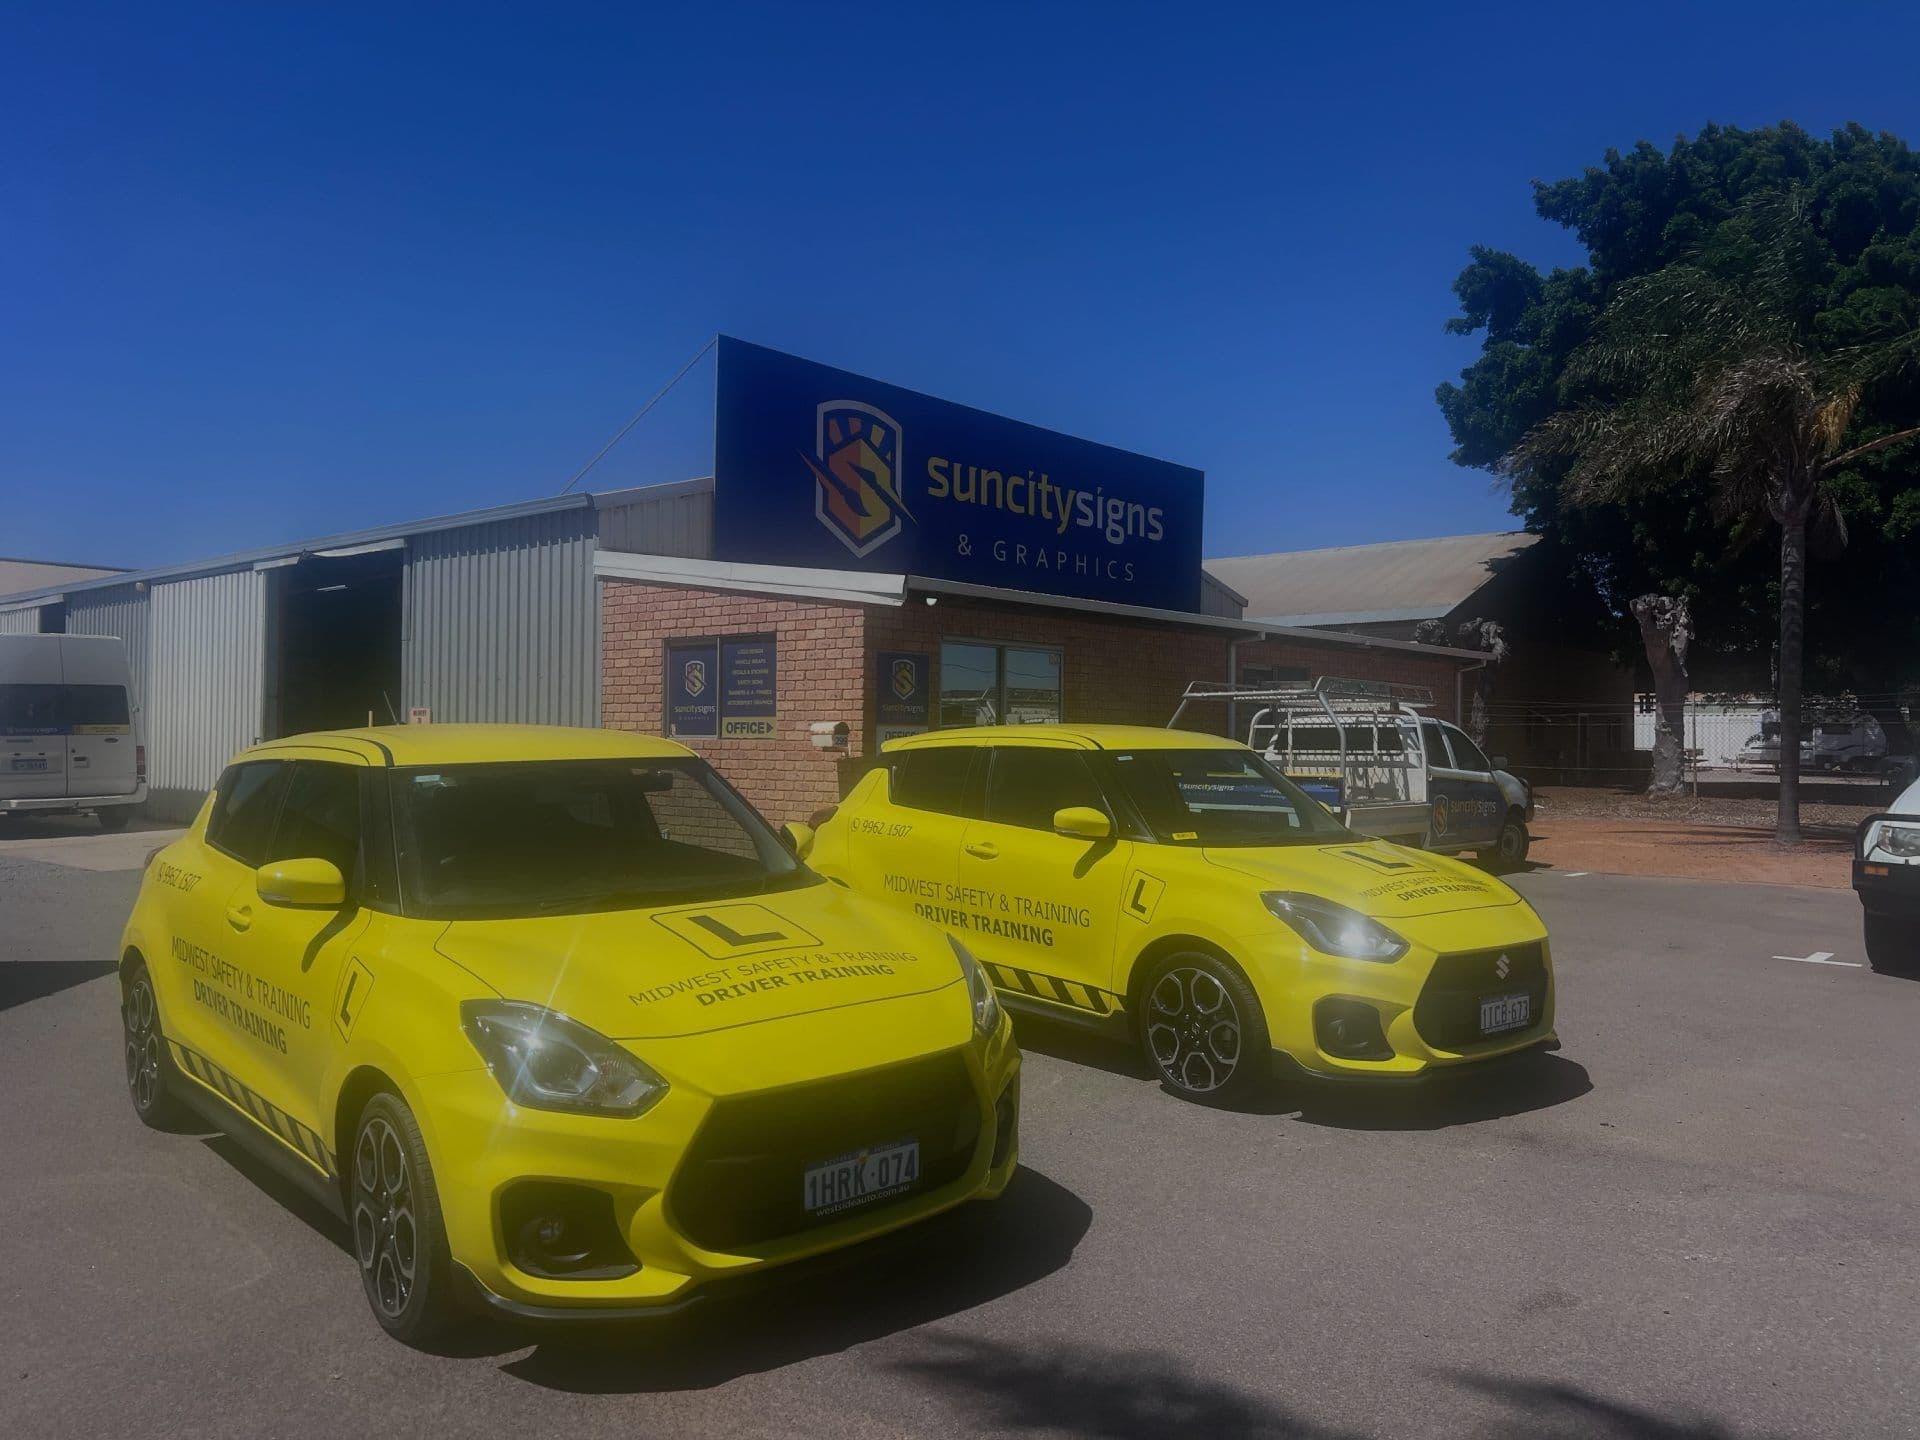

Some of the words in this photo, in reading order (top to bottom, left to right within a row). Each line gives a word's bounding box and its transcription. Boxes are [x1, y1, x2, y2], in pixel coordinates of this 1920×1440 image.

[927, 455, 1164, 545] suncitysigns
[958, 534, 973, 557] &
[993, 540, 1136, 582] GRAPHICS
[726, 721, 765, 735] OFFICE
[862, 819, 886, 835] 9962
[887, 823, 913, 838] 1507
[883, 873, 942, 900] MIDWEST
[945, 884, 995, 909] SAFETY
[999, 894, 1010, 912] &
[1014, 896, 1091, 928] TRAINING
[1130, 879, 1147, 914] L
[1396, 886, 1440, 902] DRIVER
[686, 914, 789, 947] L
[914, 902, 969, 930] DRIVER
[971, 912, 1054, 947] TRAINING
[171, 935, 210, 972] MIDWEST
[210, 954, 244, 994] SAFETY
[246, 972, 254, 1000] &
[256, 977, 311, 1030] TRAINING
[340, 970, 358, 1027] L
[628, 968, 732, 1007] MIDWEST
[736, 953, 812, 977] SAFETY
[833, 951, 919, 963] TRAINING
[695, 974, 789, 1007] DRIVER
[789, 963, 896, 984] TRAINING
[193, 978, 232, 1019] DRIVER
[231, 1007, 288, 1055] TRAINING
